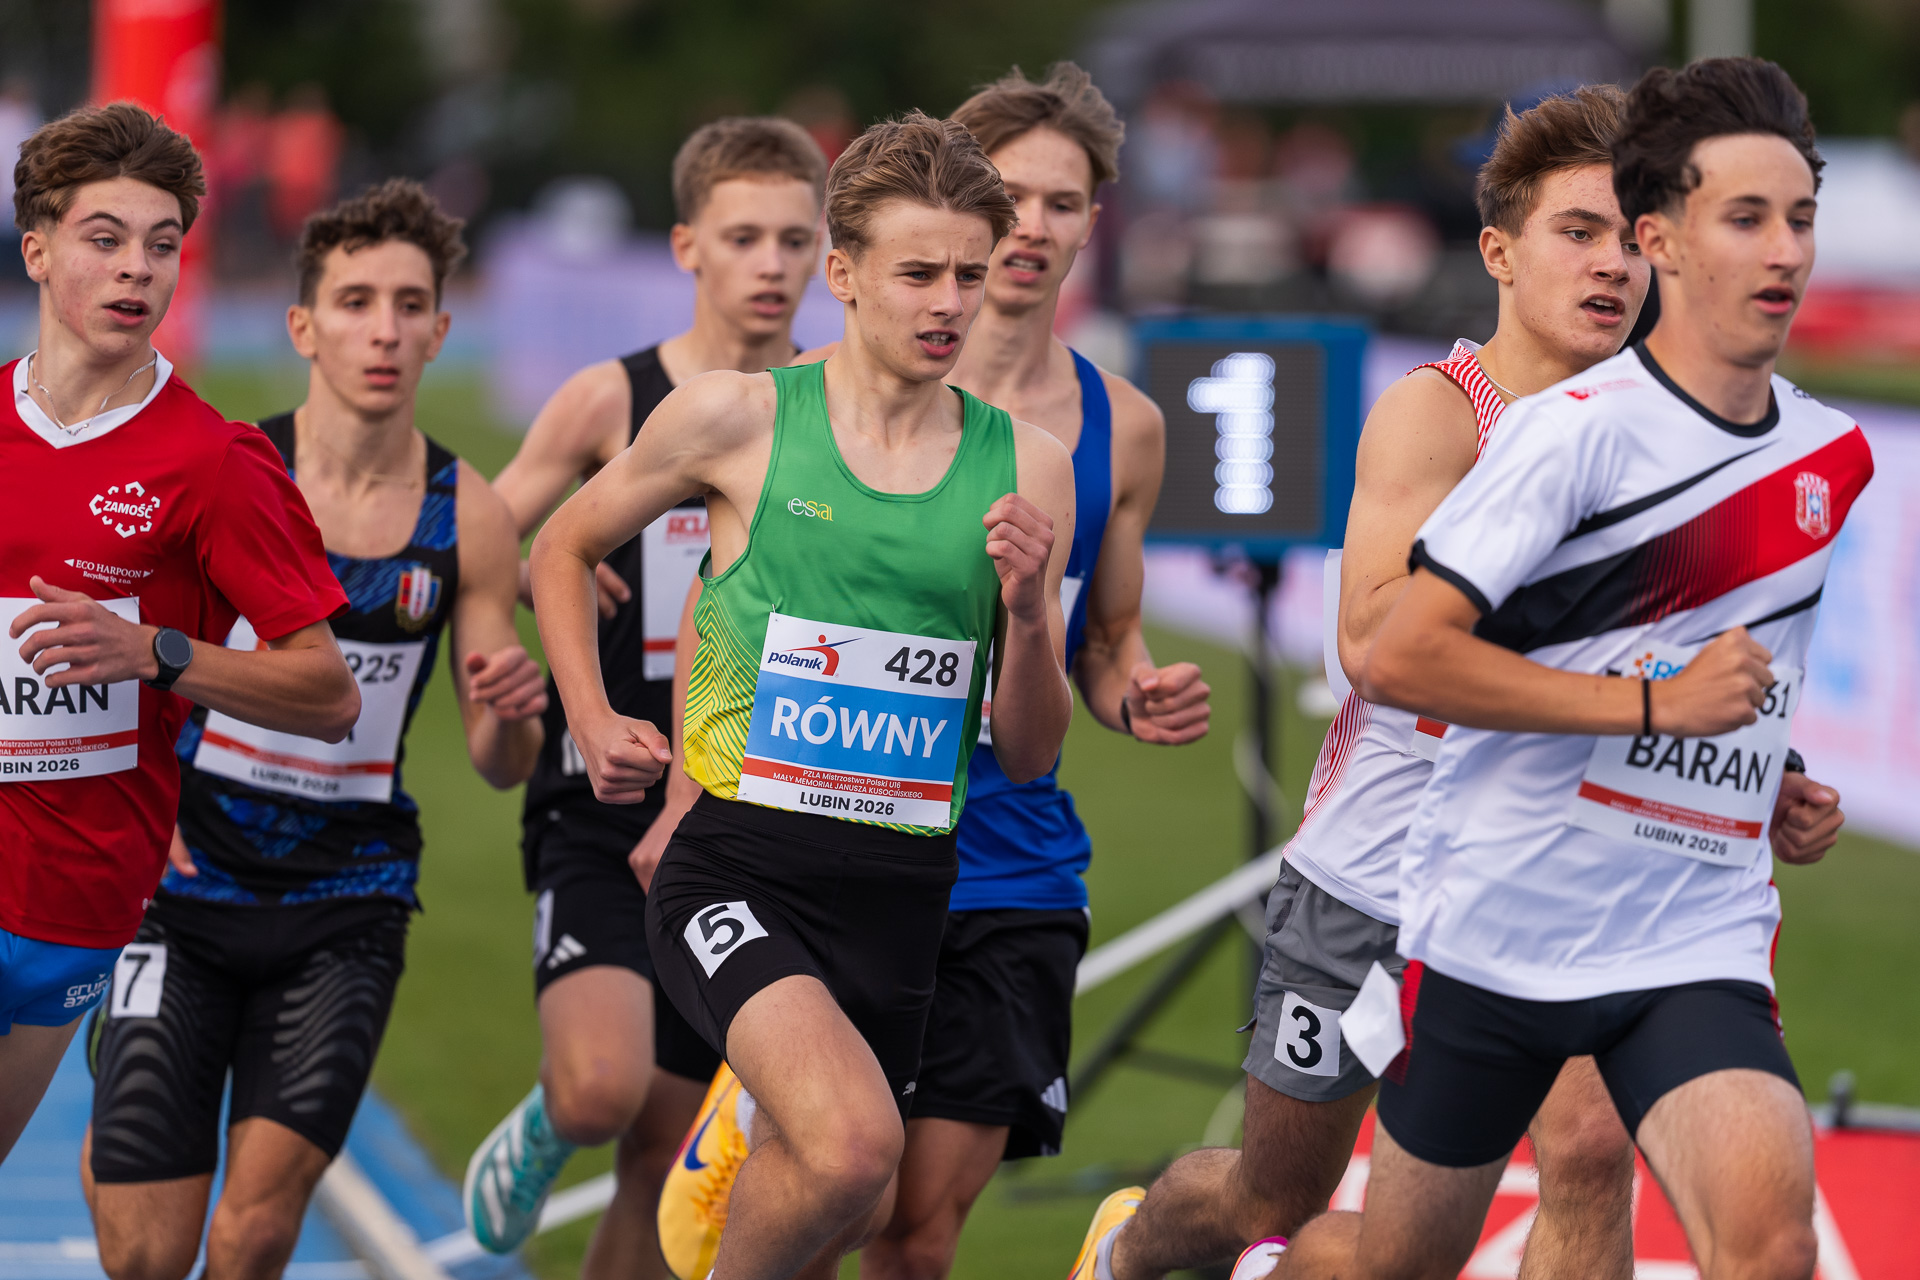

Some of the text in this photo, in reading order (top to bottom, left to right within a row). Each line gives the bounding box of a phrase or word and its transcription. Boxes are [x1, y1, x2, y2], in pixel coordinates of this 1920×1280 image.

[1187, 352, 1276, 514] 1
[103, 500, 153, 519] ZAMOŚĆ
[75, 559, 142, 578] ECO HARPOON
[82, 570, 109, 583] Recycling
[767, 646, 959, 687] polanik 428
[770, 695, 948, 759] RÓWNY
[13, 747, 48, 756] JANUSZA
[49, 742, 109, 755] KUSOCIŃSKIEGO
[45, 738, 68, 747] Polski
[69, 738, 82, 746] U16
[0, 758, 80, 774] BIN 2026
[1625, 735, 1771, 794] BARAN
[772, 772, 923, 799] MAŁY MEMORIAŁ JANUSZA KUSOCIŃSKIEGO
[802, 769, 901, 789] PZLA Mistrzostwa Polski U16
[800, 791, 895, 816] LUBIN 2026
[1633, 822, 1729, 856] LUBIN 2026
[698, 904, 745, 955] 5
[124, 954, 151, 1009] 7
[1286, 1005, 1323, 1068] 3
